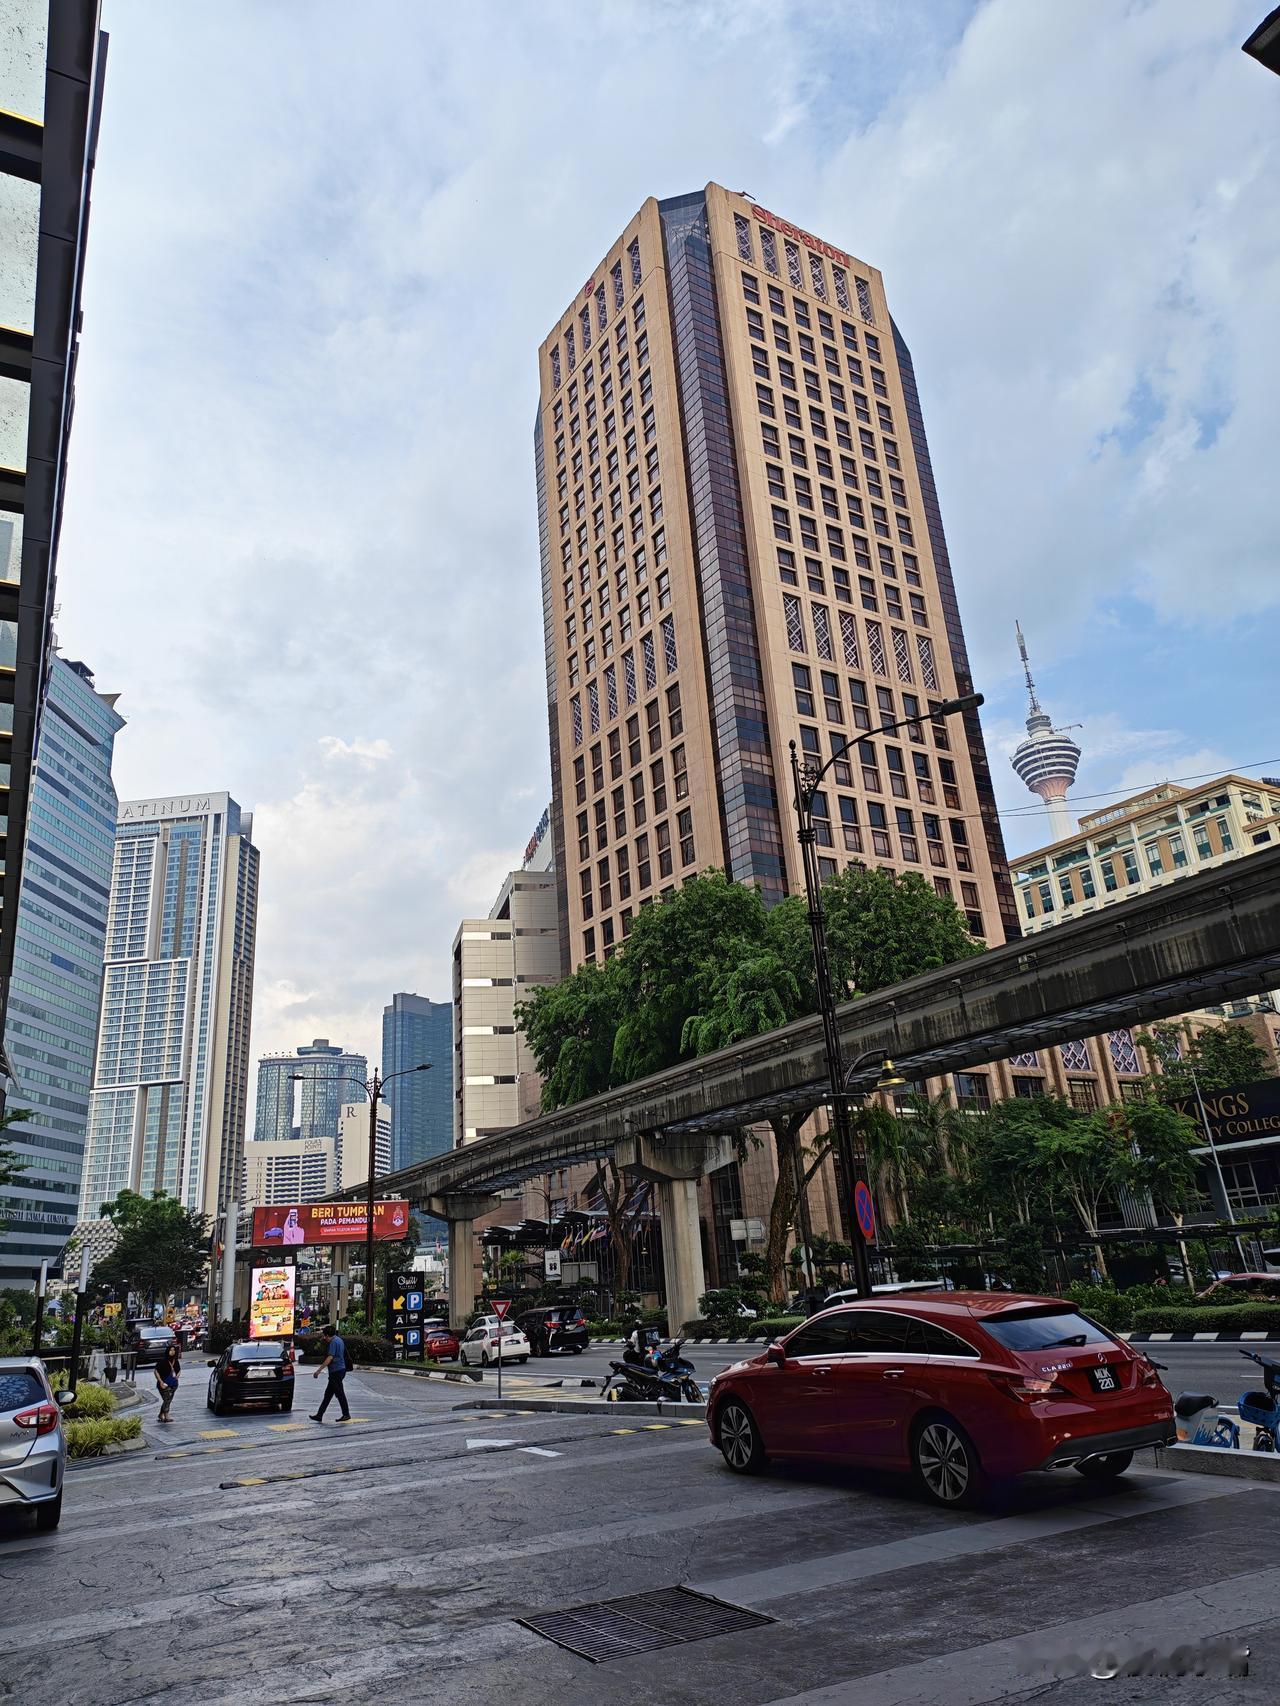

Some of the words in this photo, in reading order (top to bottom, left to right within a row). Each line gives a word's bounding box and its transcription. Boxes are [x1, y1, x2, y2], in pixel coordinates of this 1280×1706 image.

[751, 204, 850, 269] Sheraton
[346, 1106, 358, 1118] R
[1174, 1092, 1249, 1121] KINGS
[311, 1207, 334, 1218] BERI
[320, 1218, 337, 1226] PADA
[338, 1216, 376, 1225] PEMANDU
[410, 1294, 420, 1309] P
[395, 1317, 404, 1325] A
[410, 1332, 418, 1344] P
[1041, 1365, 1057, 1373] CLA
[1098, 1377, 1115, 1390] 220
